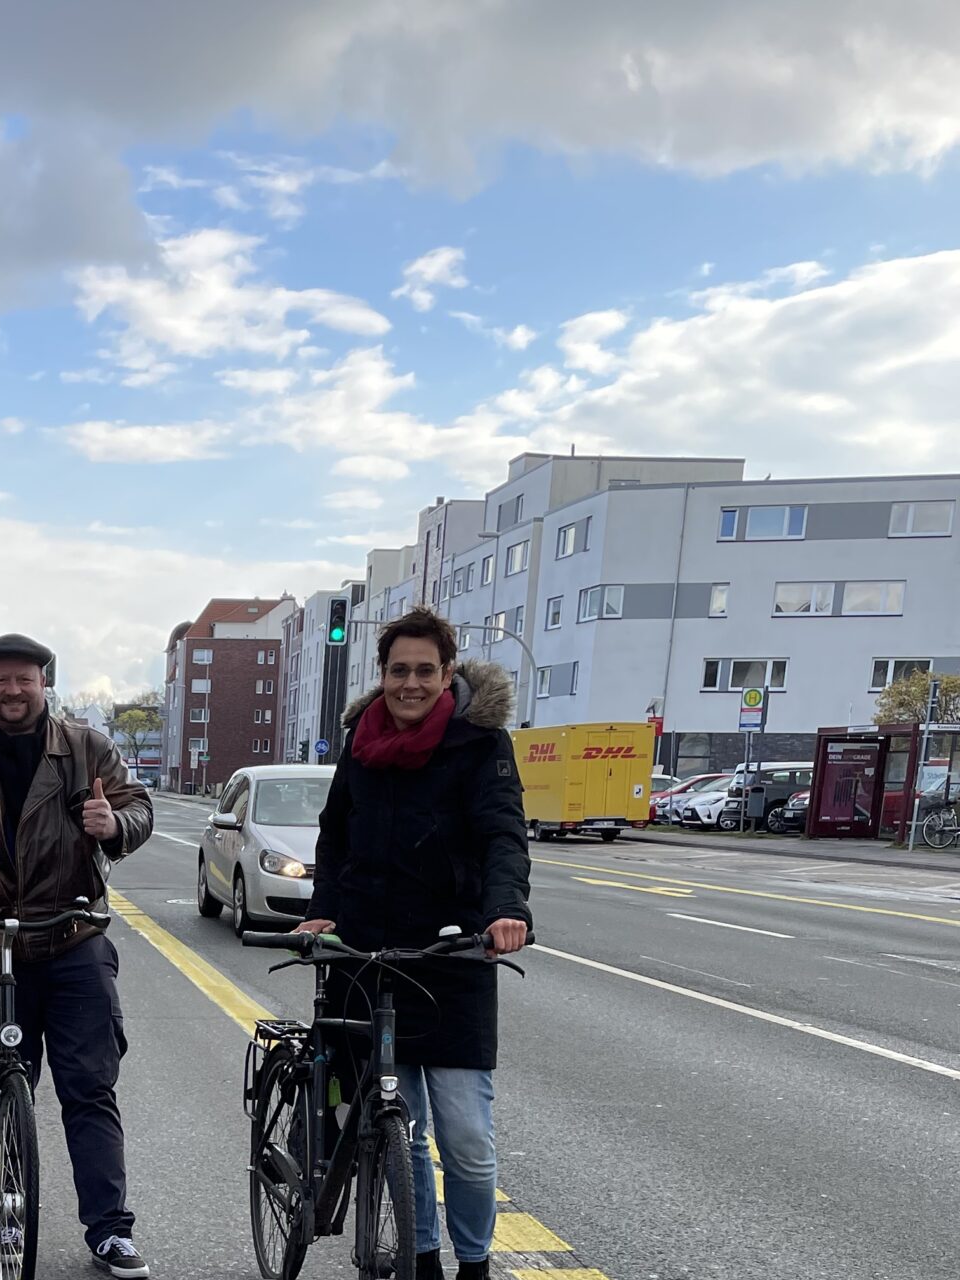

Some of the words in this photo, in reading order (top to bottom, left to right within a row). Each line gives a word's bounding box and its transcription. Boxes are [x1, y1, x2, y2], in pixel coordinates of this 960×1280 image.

[748, 692, 758, 704] H
[526, 742, 558, 763] DHL
[581, 746, 638, 760] DHL
